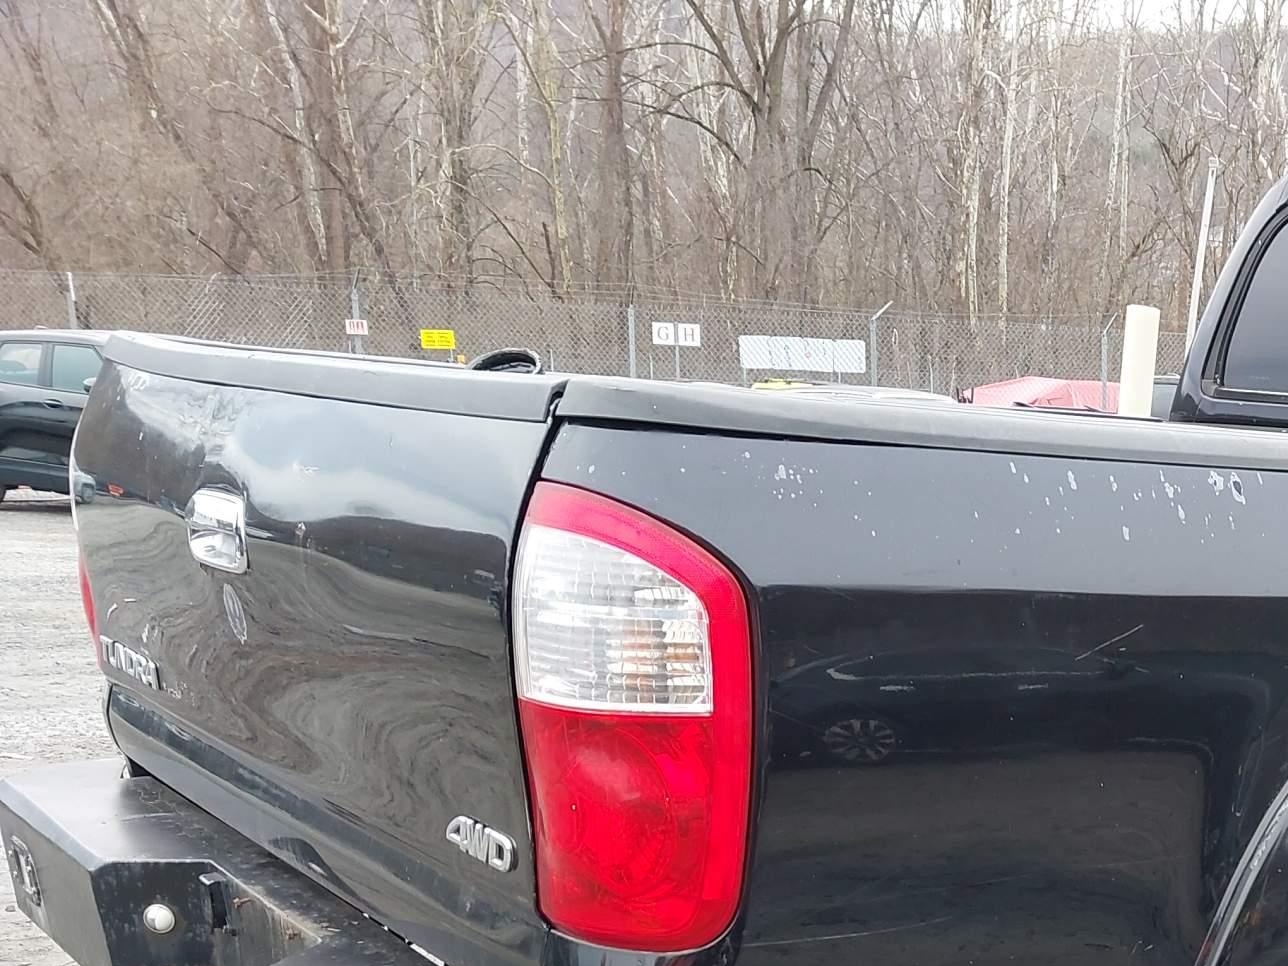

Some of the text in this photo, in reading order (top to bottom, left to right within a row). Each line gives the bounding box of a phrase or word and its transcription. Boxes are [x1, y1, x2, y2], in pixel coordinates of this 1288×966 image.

[657, 327, 669, 341] G
[684, 328, 694, 341] H
[99, 634, 158, 691] TUNDRA
[446, 815, 512, 873] 4WD
